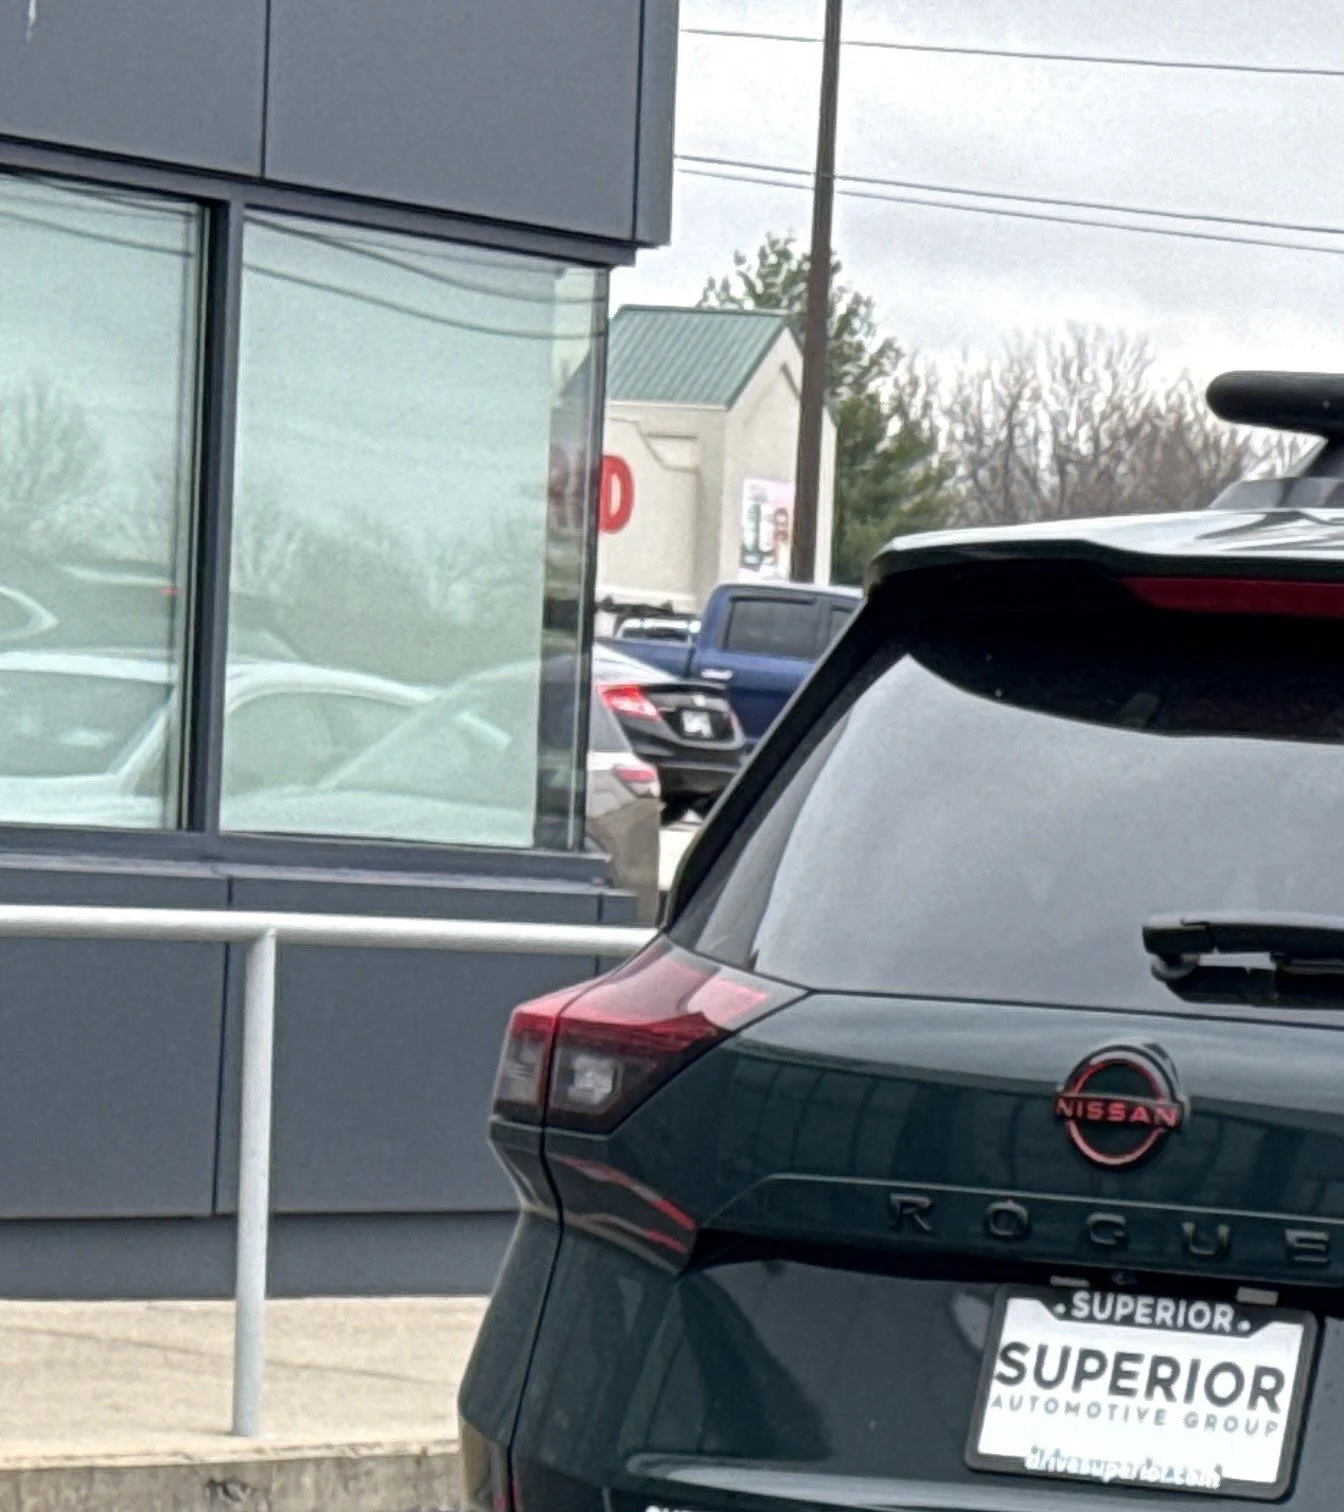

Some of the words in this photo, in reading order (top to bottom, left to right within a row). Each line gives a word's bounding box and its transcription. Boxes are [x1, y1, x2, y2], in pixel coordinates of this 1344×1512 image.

[1056, 1096, 1179, 1128] NISSAN
[890, 1192, 1332, 1264] ROGUE
[1071, 1290, 1235, 1333] SUPERIOR
[994, 1341, 1286, 1414] SUPERIOR
[991, 1393, 1168, 1428] AUTOMOTIVE
[1183, 1412, 1279, 1438] GROUP
